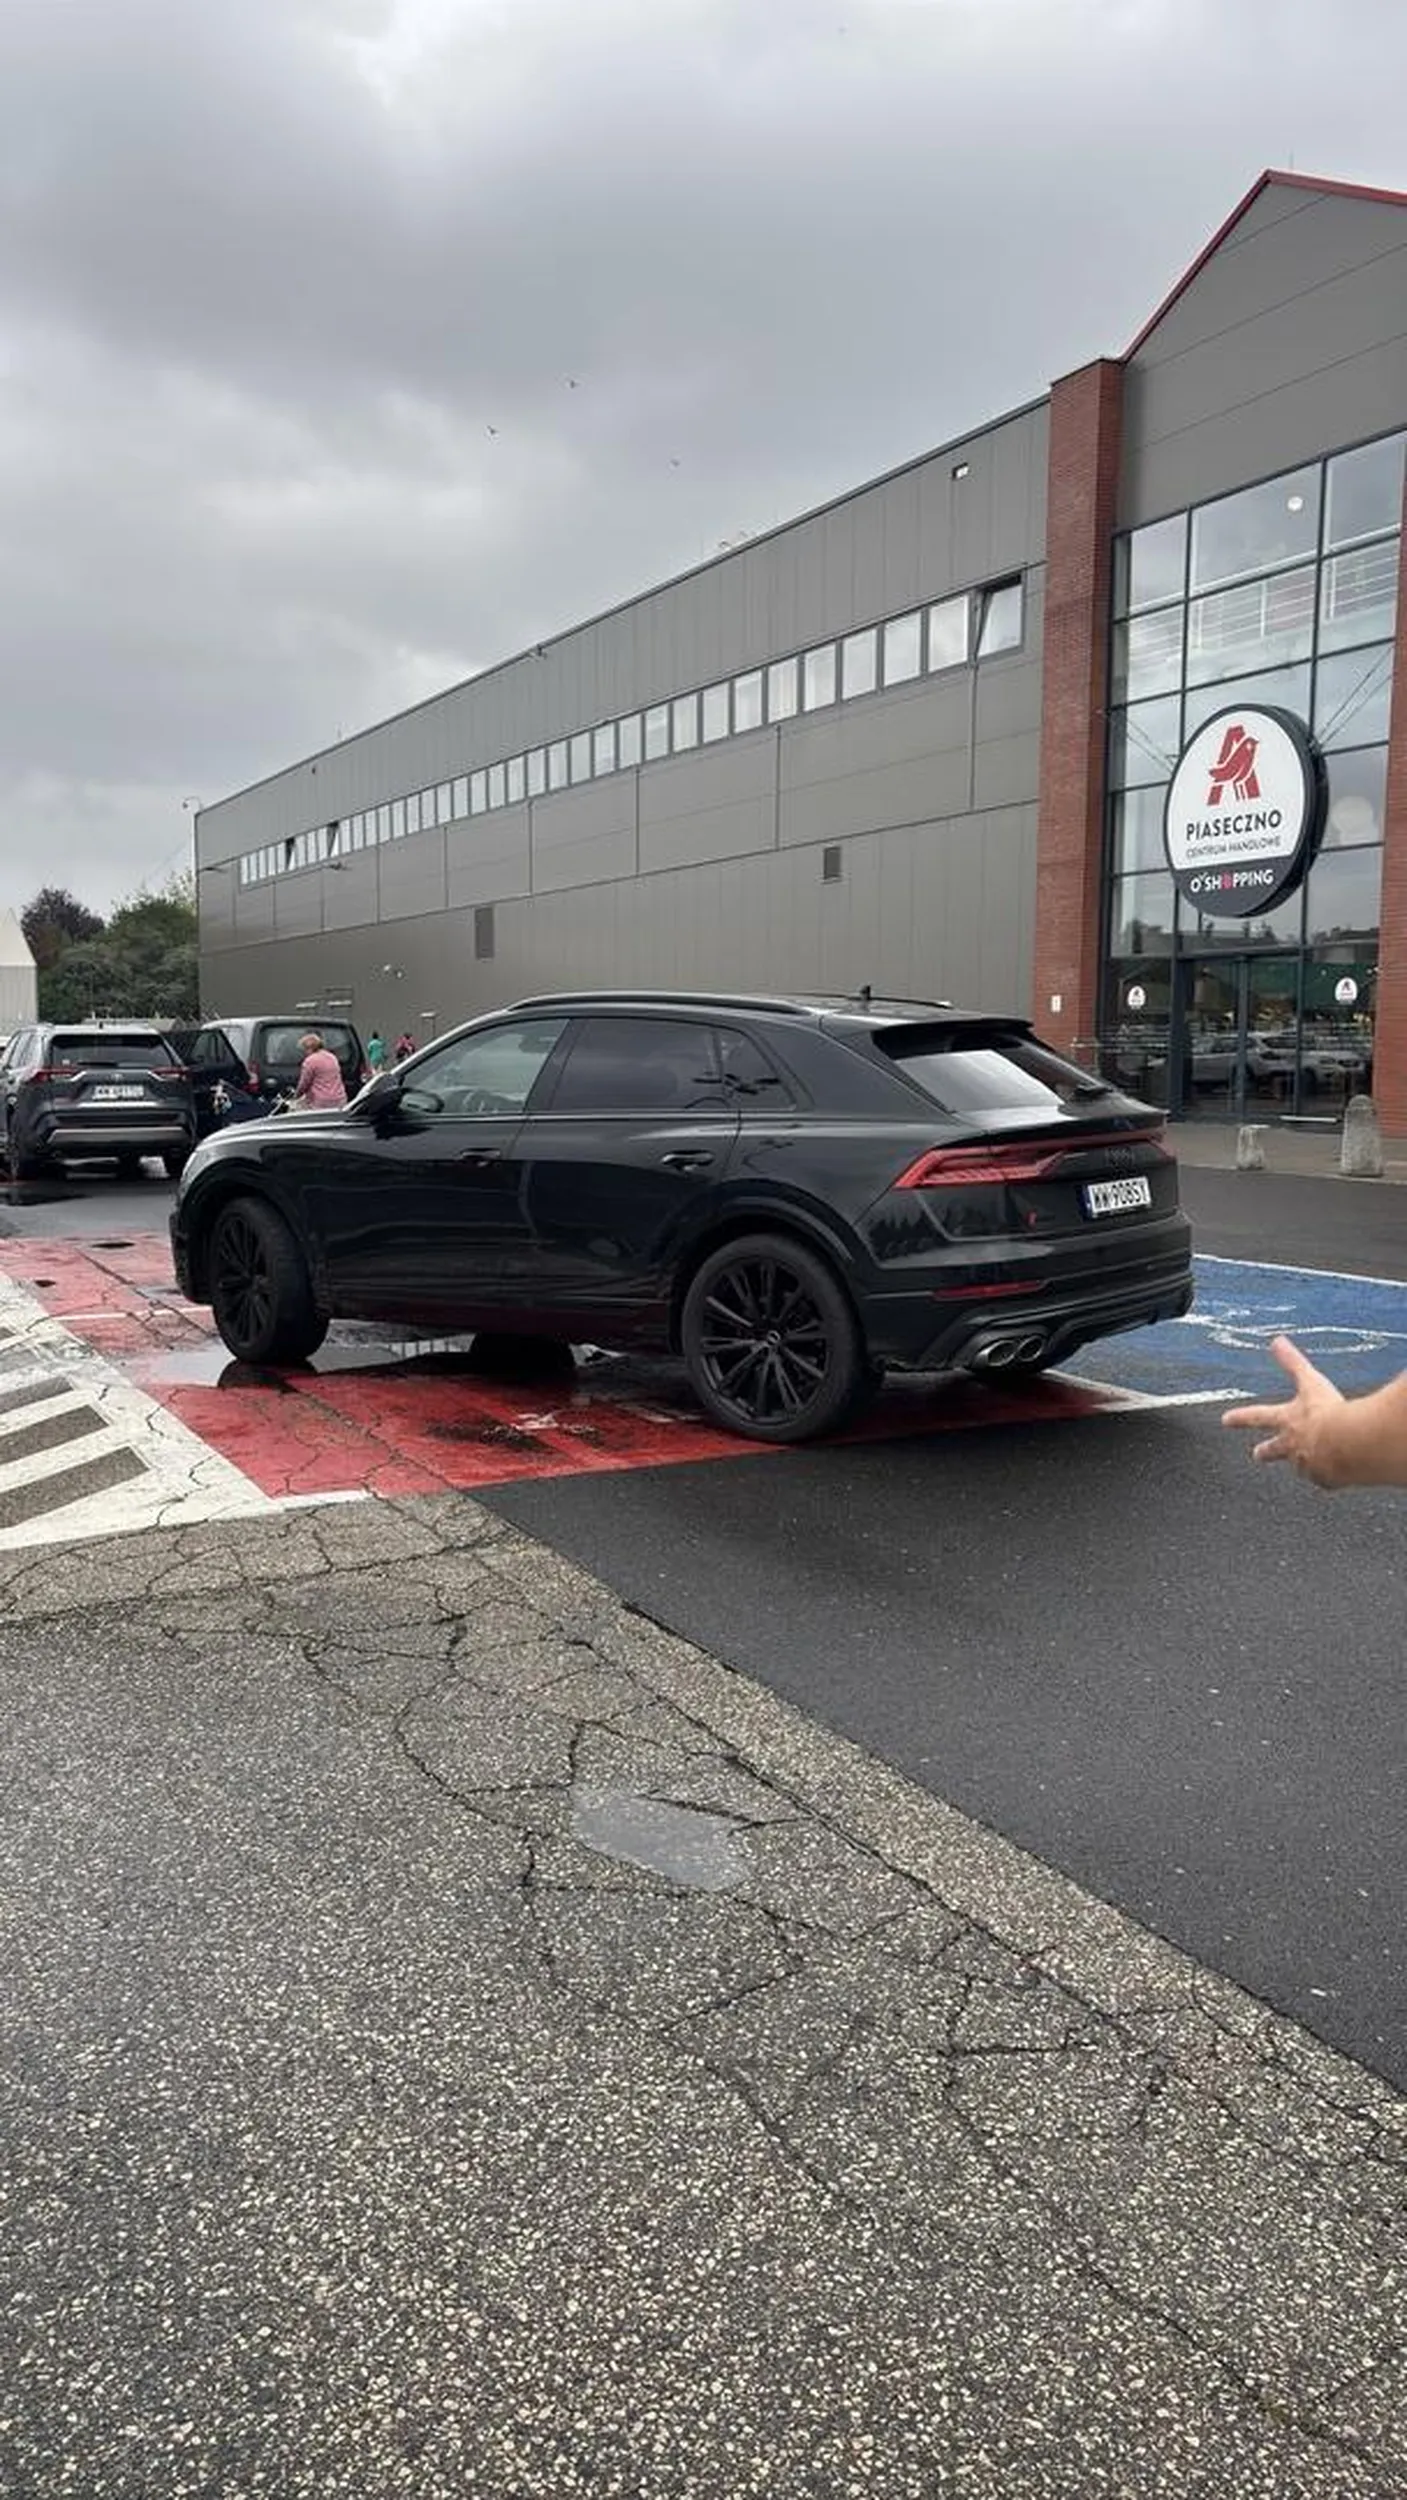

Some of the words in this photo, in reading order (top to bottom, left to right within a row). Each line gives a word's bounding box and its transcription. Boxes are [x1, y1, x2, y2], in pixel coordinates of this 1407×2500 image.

[1186, 809, 1282, 841] PIASECZNO
[1187, 844, 1227, 858] CENTRUM
[1229, 836, 1281, 852] HANDLOWE
